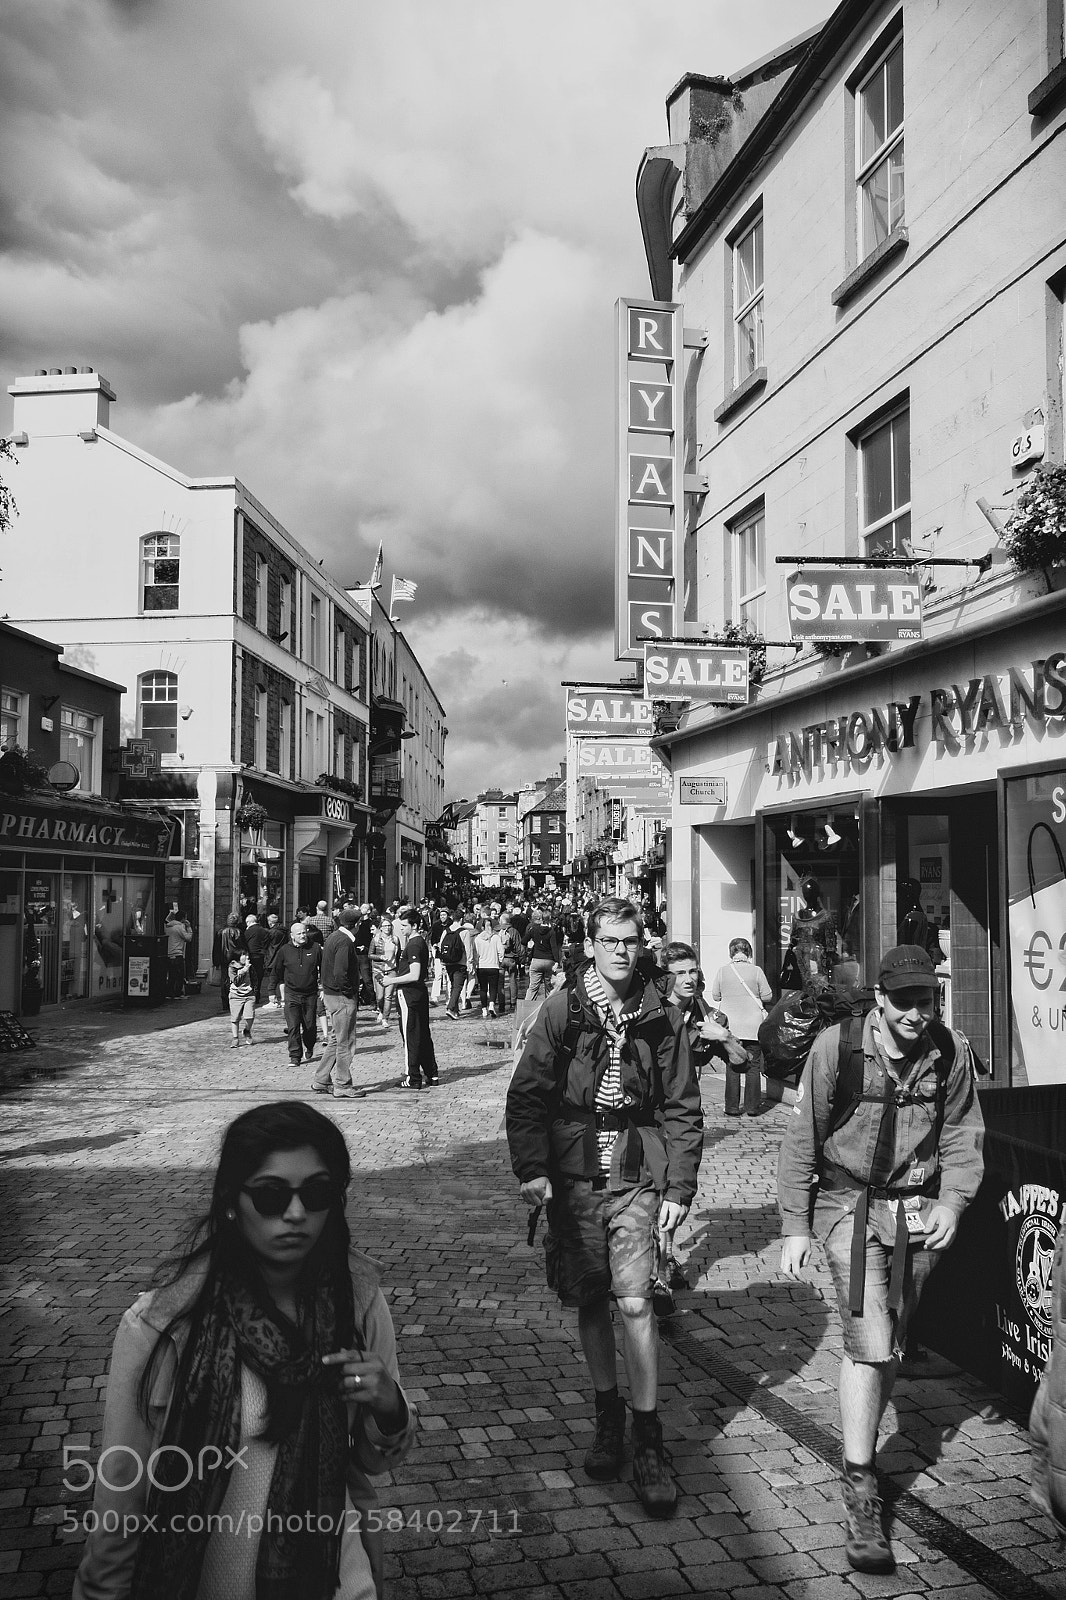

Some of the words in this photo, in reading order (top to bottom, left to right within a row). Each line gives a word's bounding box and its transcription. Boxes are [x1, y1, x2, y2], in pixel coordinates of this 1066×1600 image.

[636, 317, 667, 637] RYANS
[789, 584, 920, 620] SALE
[646, 656, 747, 687] SALE
[568, 699, 652, 723] SALE
[771, 696, 922, 777] ANTHONY
[930, 652, 1066, 741] RYANS
[580, 747, 651, 766] SALE
[681, 780, 724, 788] Augustinian
[326, 797, 350, 821] eason
[0, 813, 126, 847] PHARMACY
[996, 1303, 1021, 1342] Live
